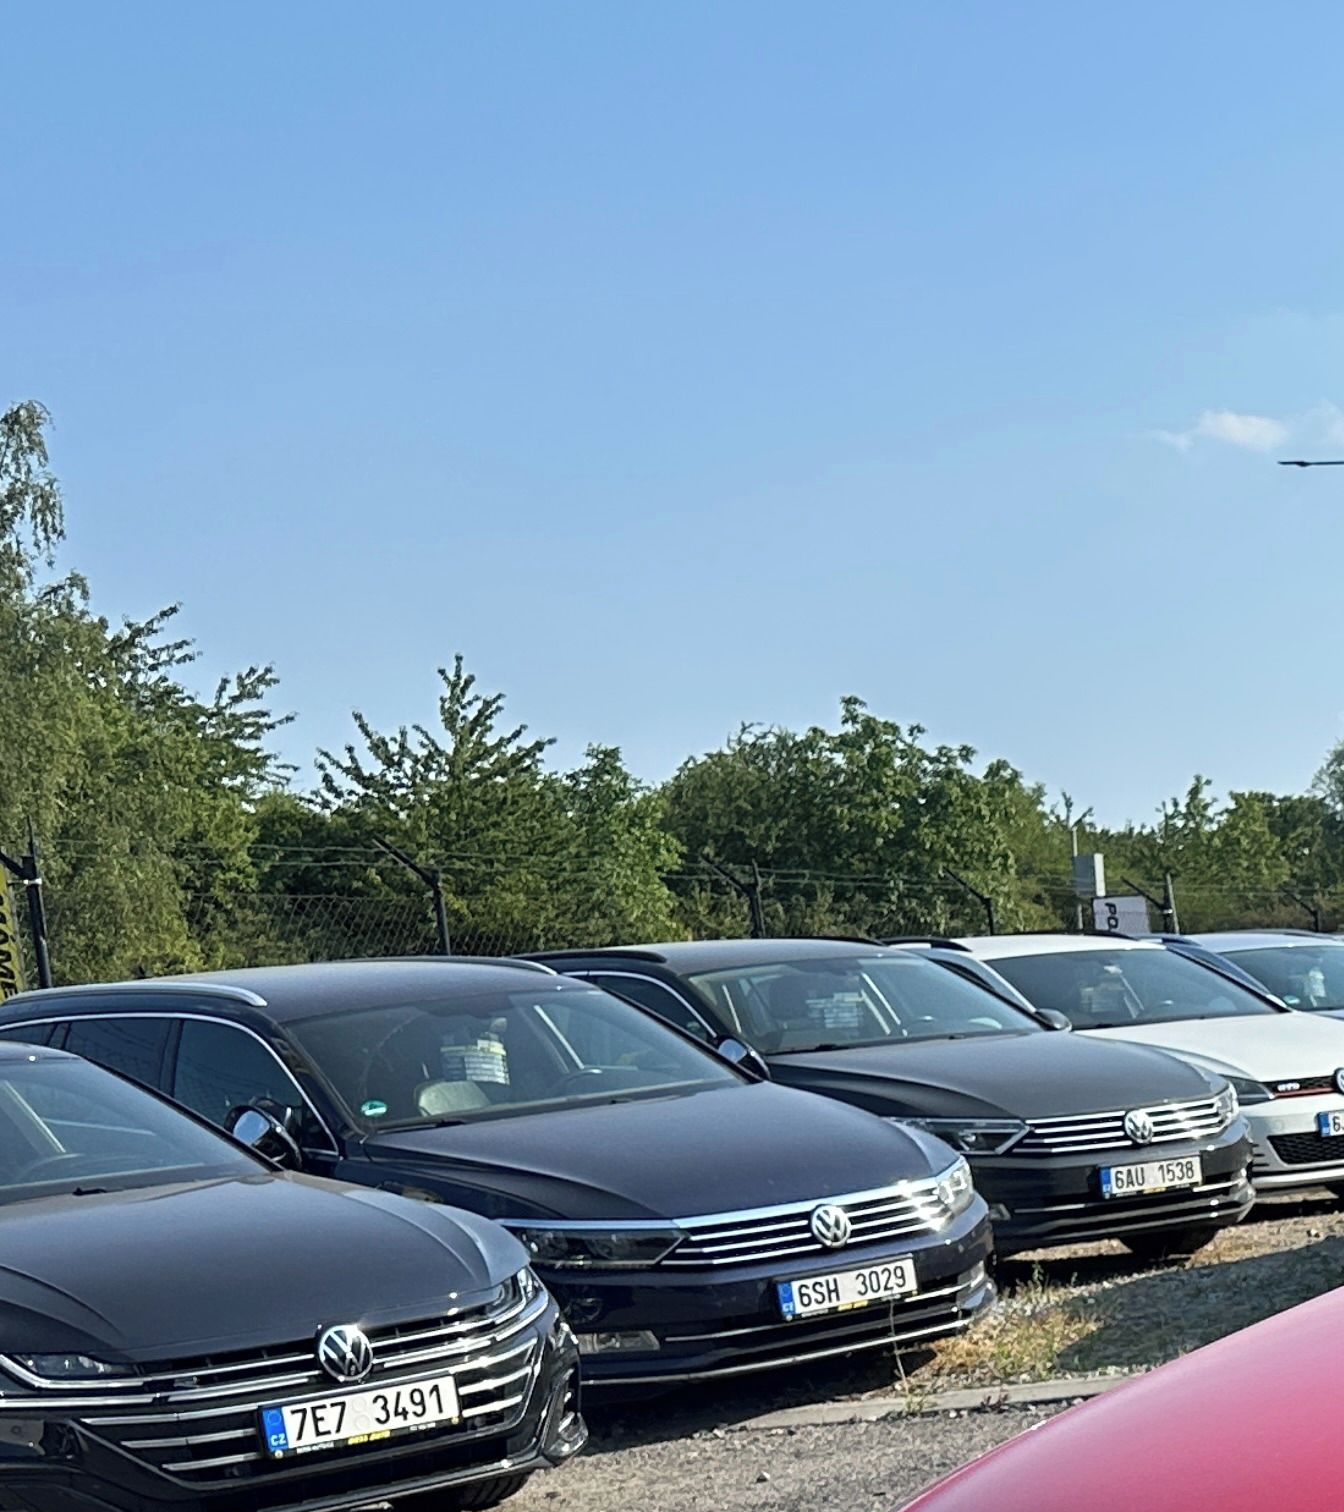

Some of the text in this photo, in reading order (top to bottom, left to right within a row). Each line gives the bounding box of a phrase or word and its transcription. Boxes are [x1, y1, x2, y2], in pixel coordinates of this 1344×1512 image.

[1115, 1161, 1195, 1189] 6AU 1538
[798, 1265, 906, 1307] 6SH 3029
[290, 1401, 346, 1441] 7E7
[372, 1384, 443, 1424] 3491
[270, 1433, 287, 1446] CZ
